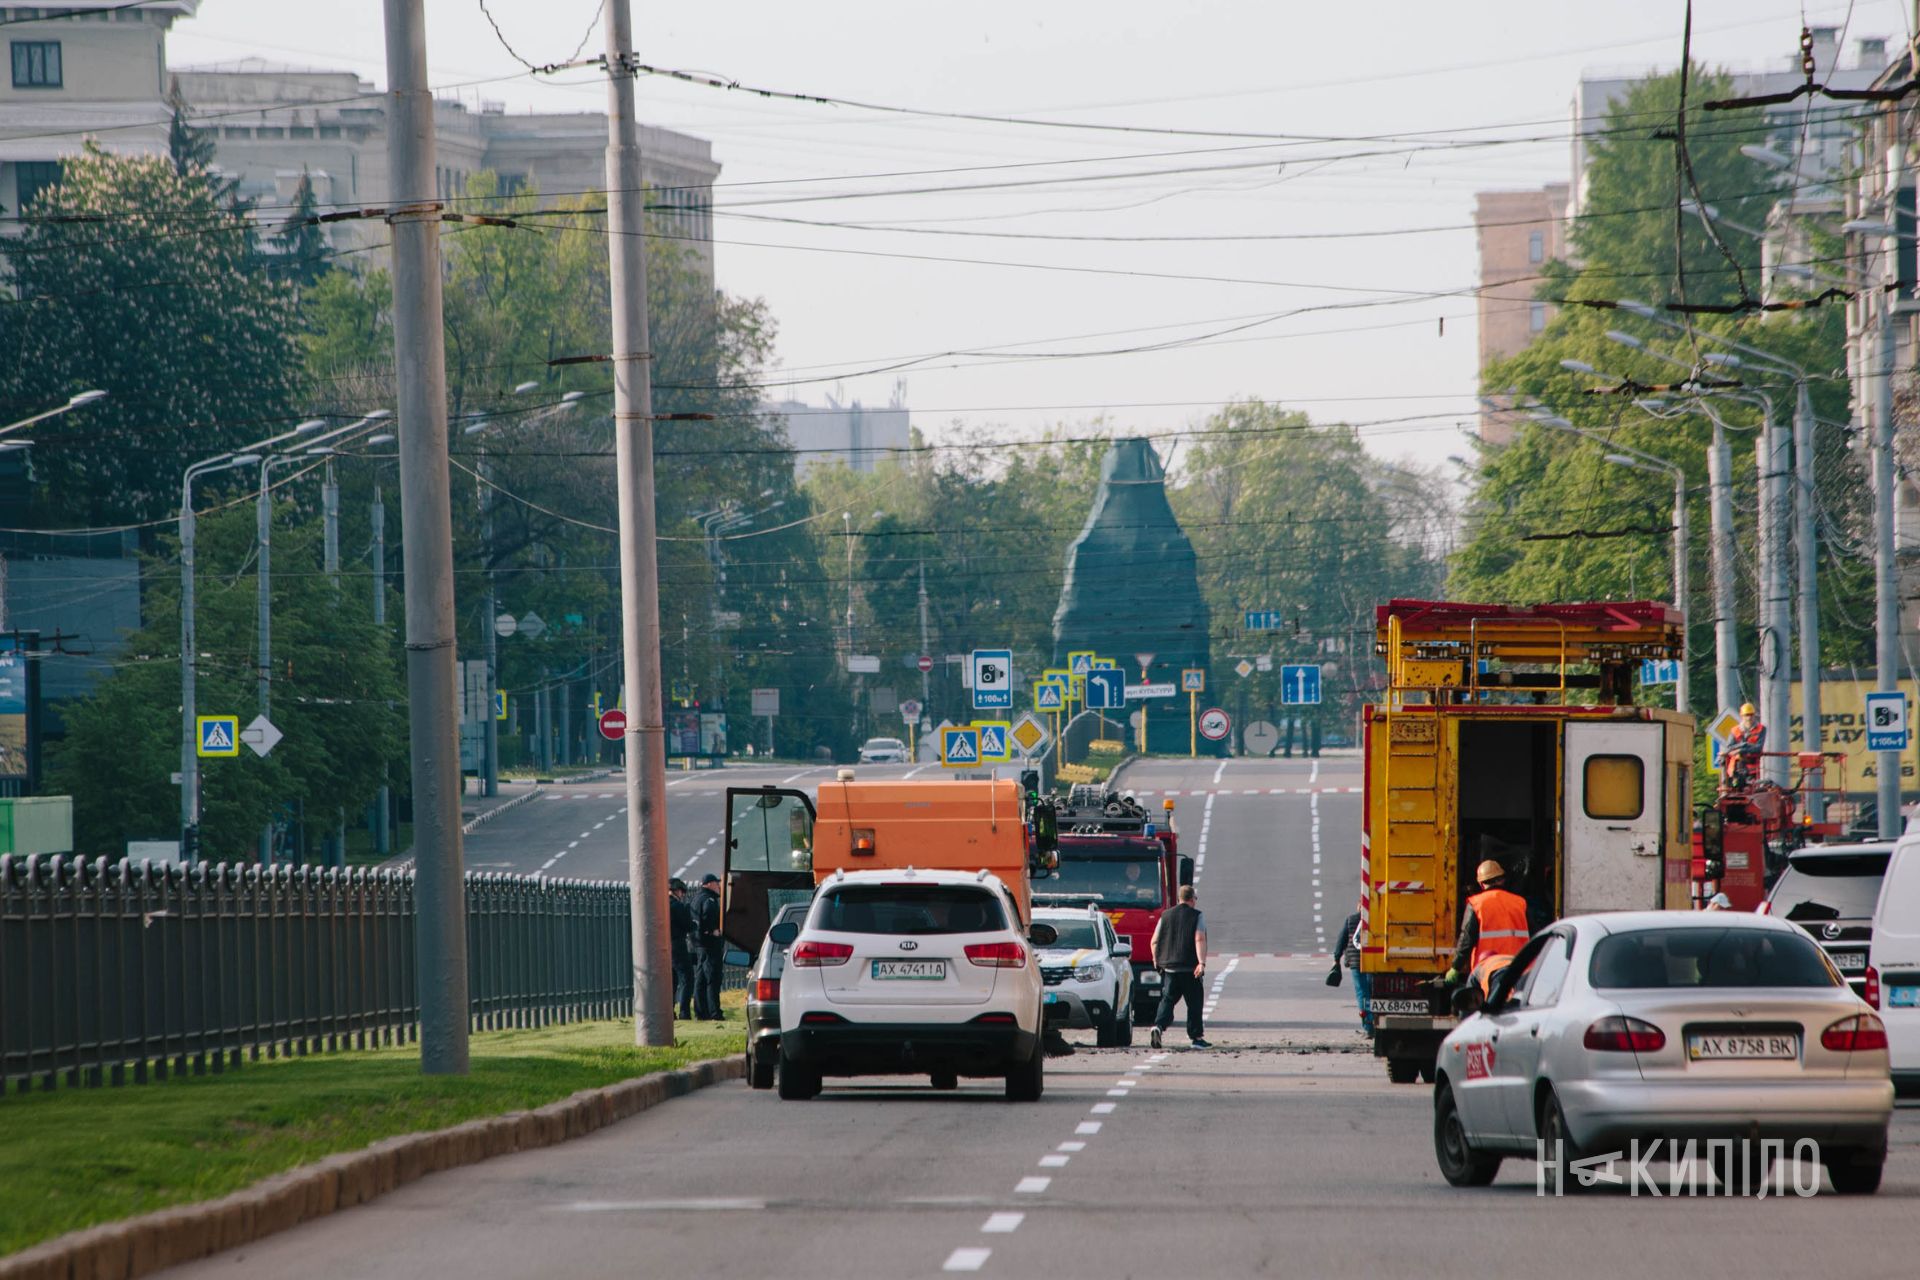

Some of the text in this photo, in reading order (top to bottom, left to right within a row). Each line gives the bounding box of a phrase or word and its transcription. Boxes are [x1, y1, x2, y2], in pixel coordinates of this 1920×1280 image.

[901, 941, 918, 950] KIA
[880, 964, 897, 976] AX
[900, 964, 926, 976] 4741
[1372, 1000, 1387, 1012] AX
[1388, 1000, 1412, 1012] 6849
[1702, 1037, 1793, 1056] AX 8758 BK
